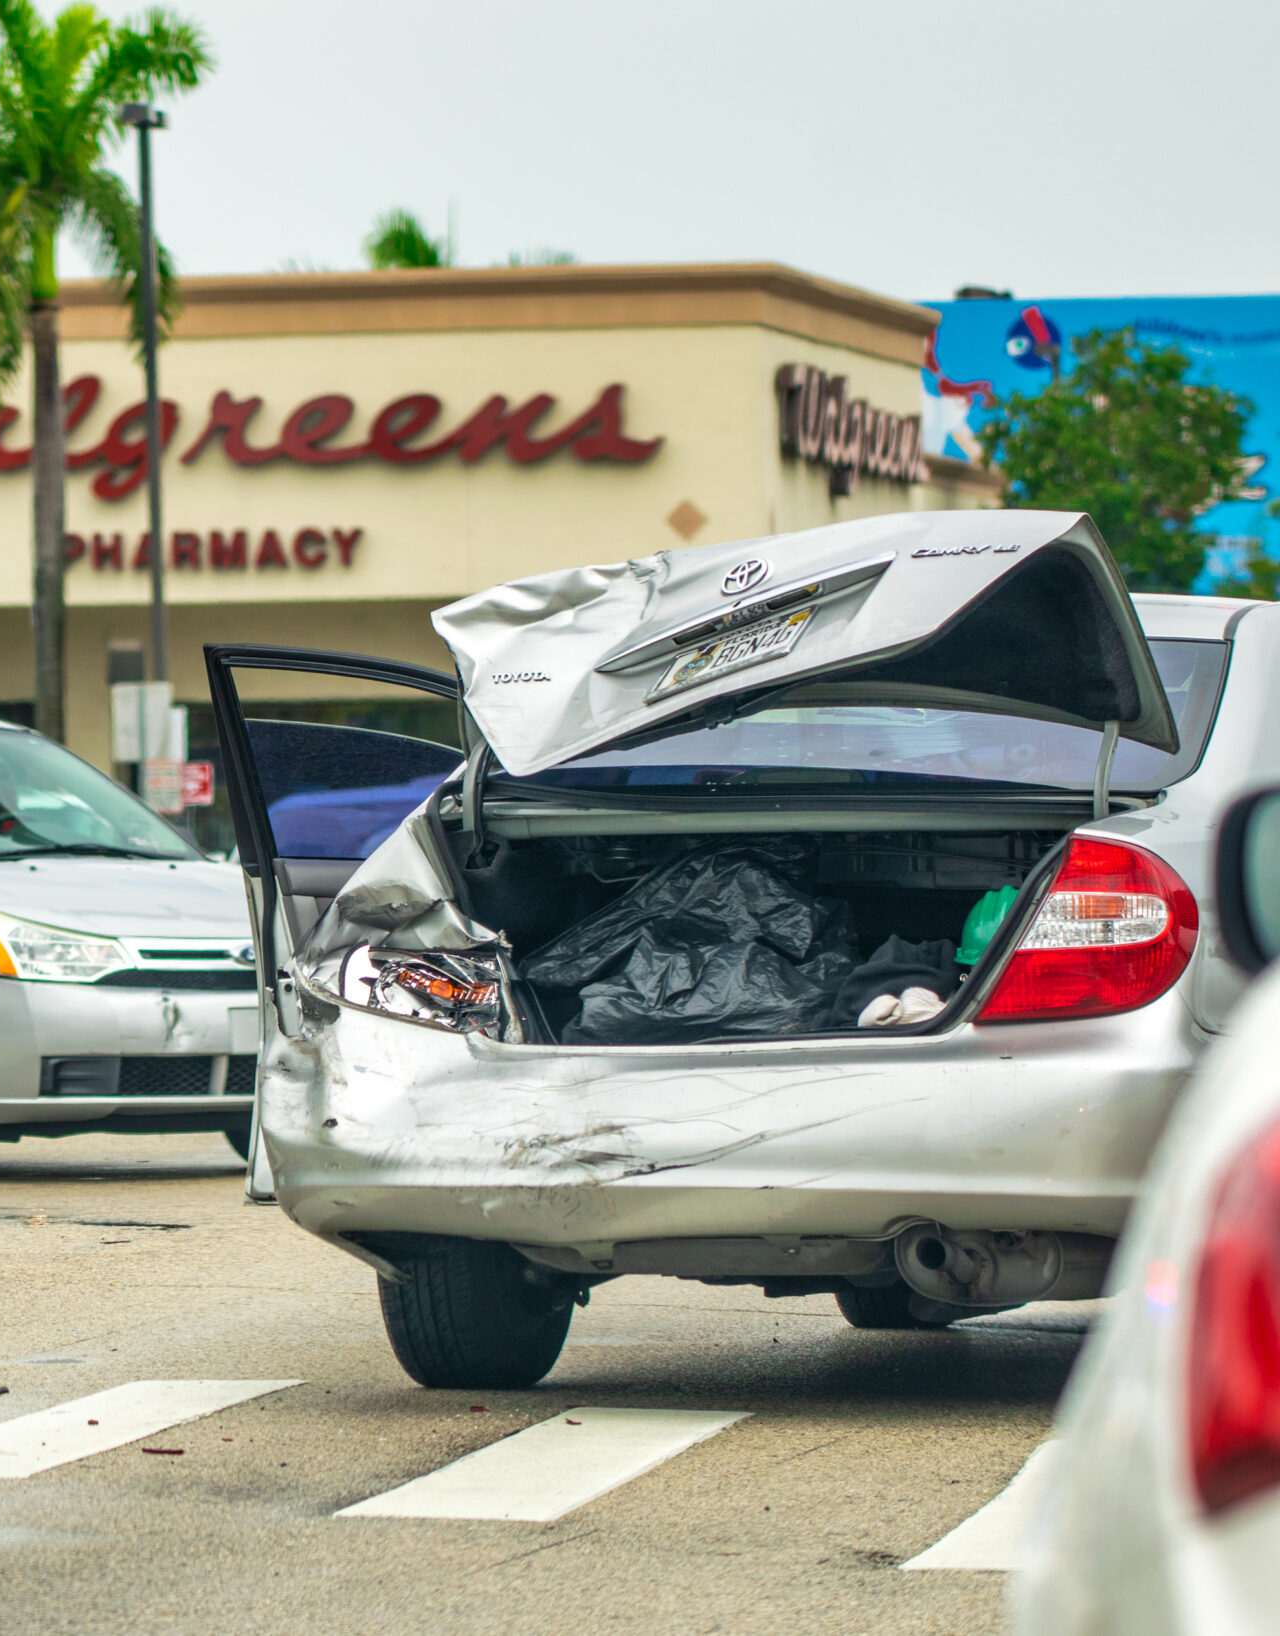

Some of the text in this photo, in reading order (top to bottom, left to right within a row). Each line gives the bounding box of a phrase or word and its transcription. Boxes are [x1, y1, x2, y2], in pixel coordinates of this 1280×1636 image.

[910, 543, 1021, 559] CAMRY LE
[491, 670, 552, 685] TOYOTA
